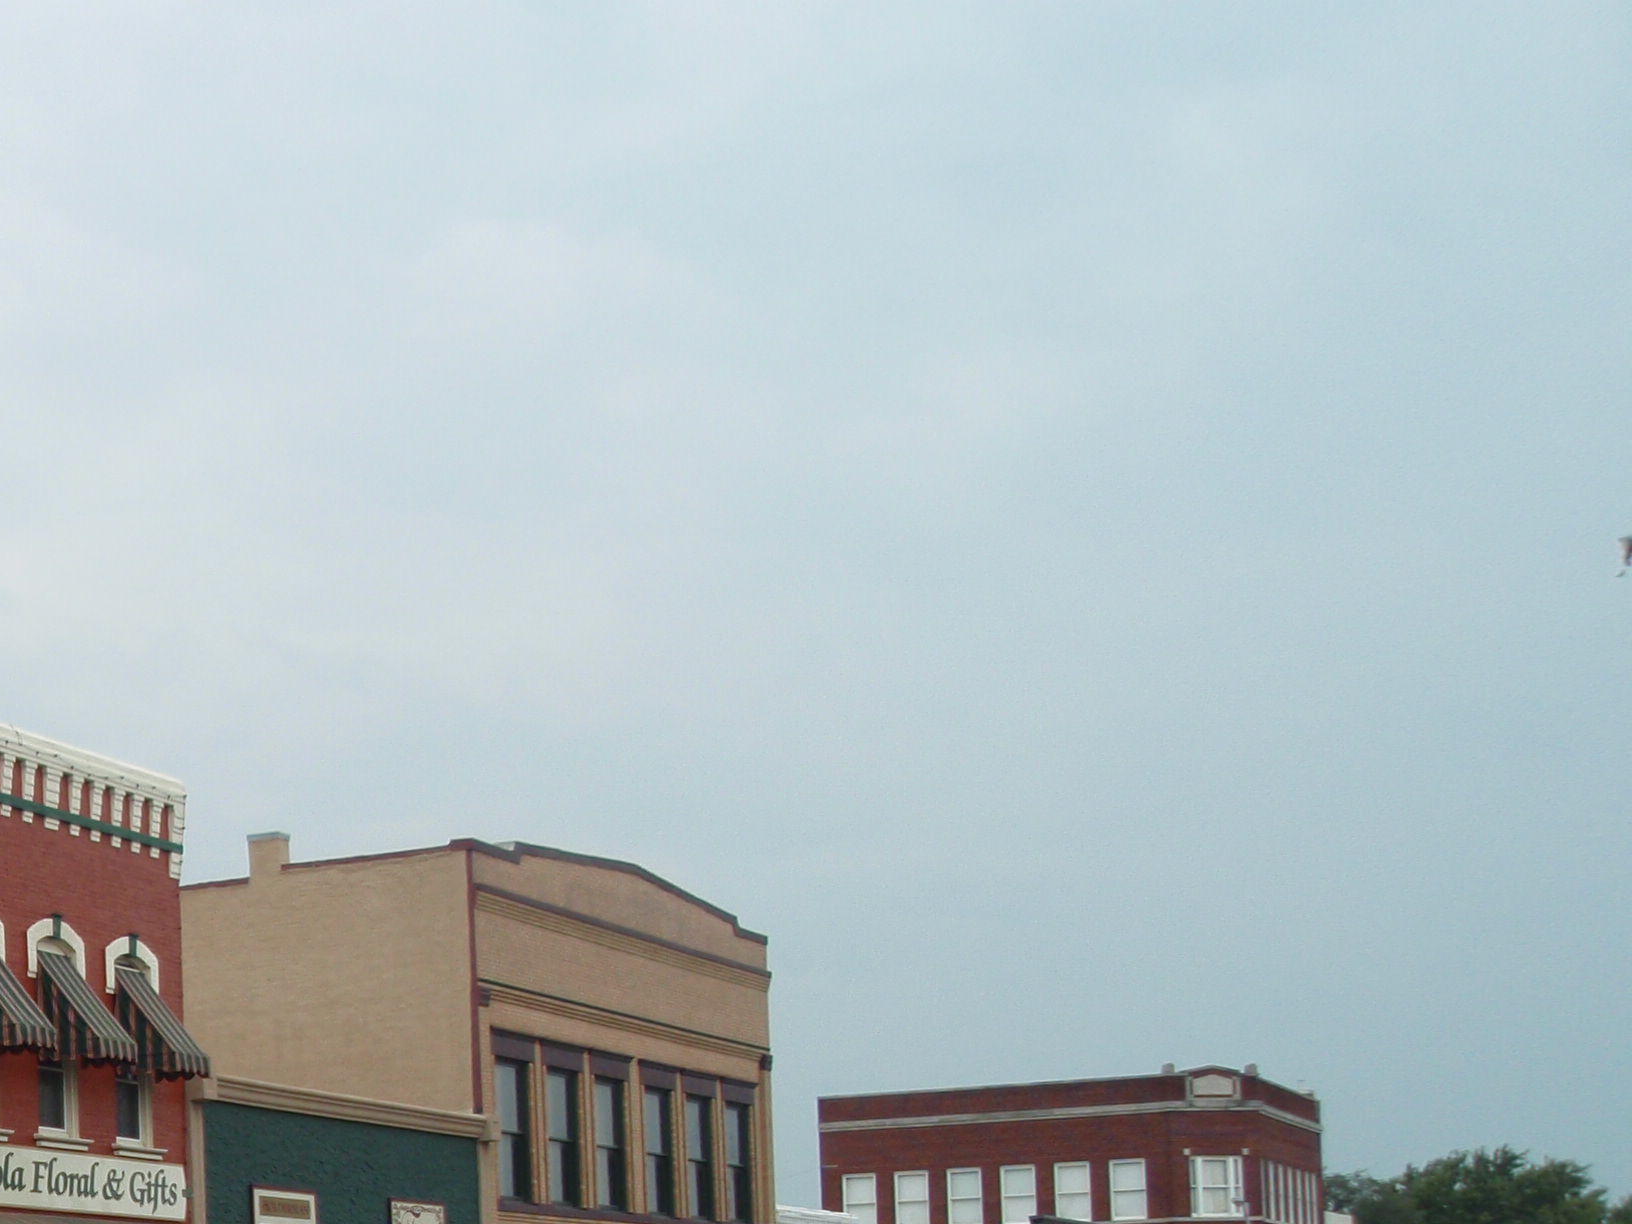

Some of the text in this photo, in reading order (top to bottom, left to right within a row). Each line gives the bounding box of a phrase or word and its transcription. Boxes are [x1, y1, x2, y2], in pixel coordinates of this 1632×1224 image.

[30, 1157, 99, 1199] Floral
[102, 1168, 125, 1201] &
[129, 1168, 178, 1215] Gifts
